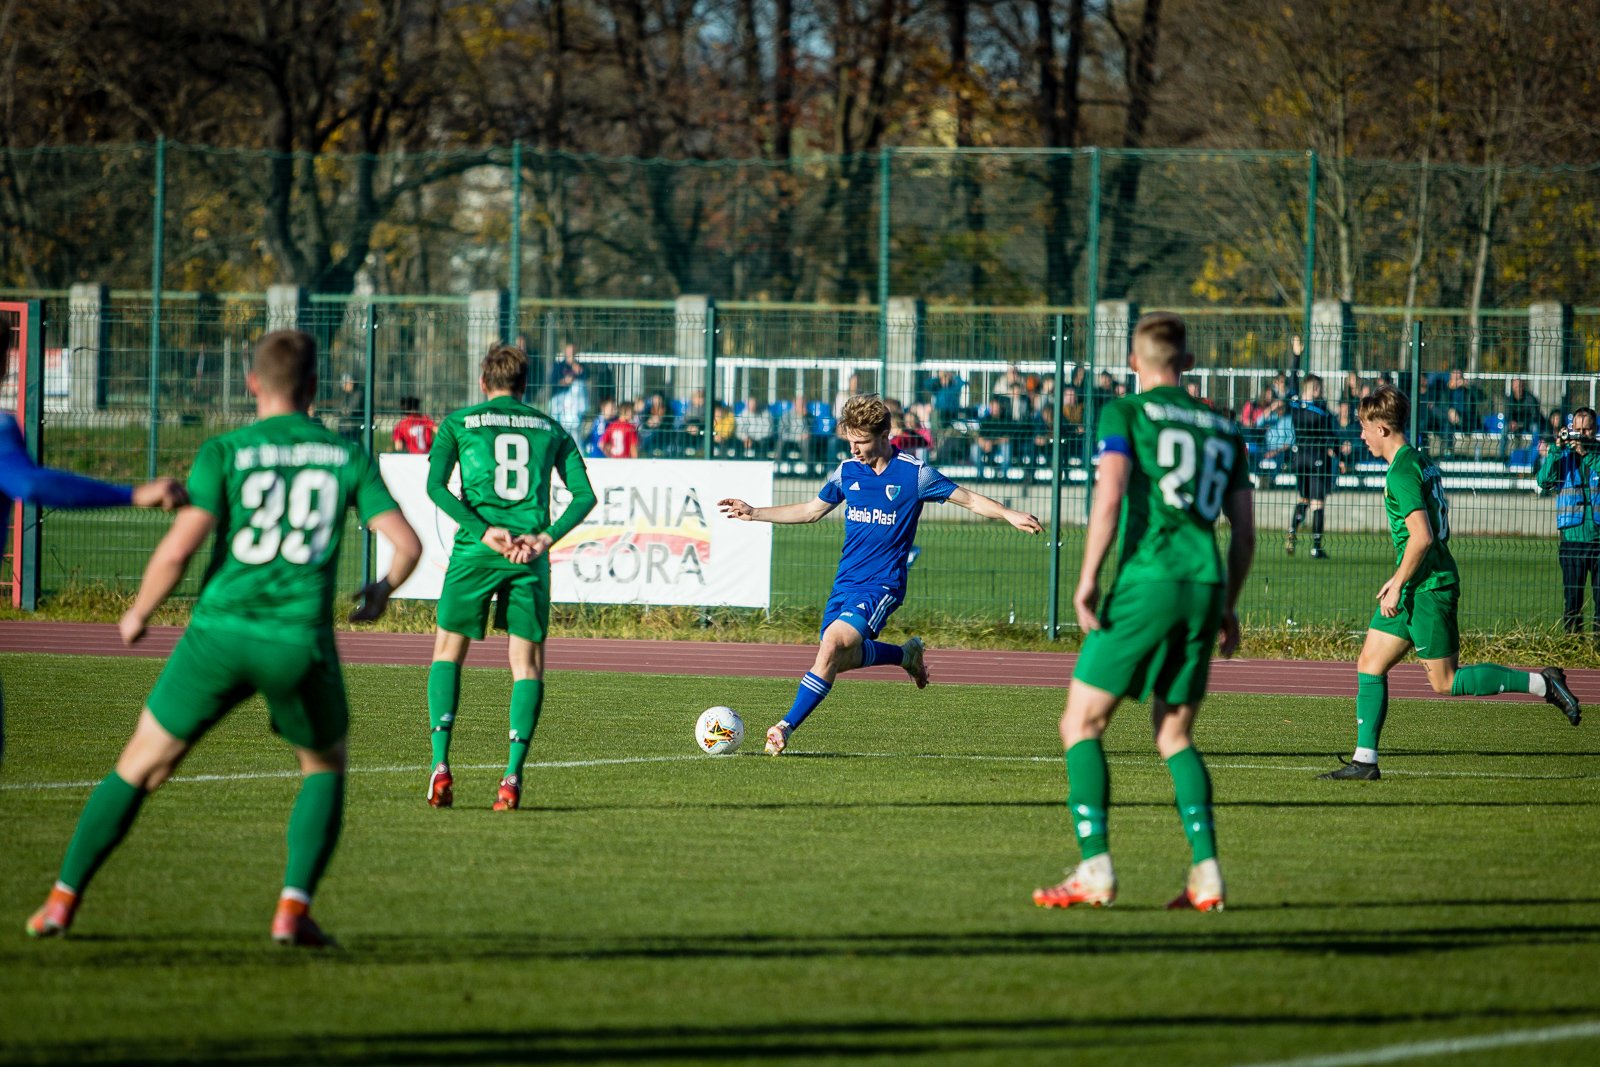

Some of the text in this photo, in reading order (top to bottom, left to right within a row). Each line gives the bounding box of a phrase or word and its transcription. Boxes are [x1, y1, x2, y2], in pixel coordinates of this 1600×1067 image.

[494, 433, 530, 501] 8
[1157, 428, 1236, 521] 26
[232, 469, 339, 565] 39
[847, 505, 897, 525] Jelenia Plast
[573, 531, 707, 586] GÓRA
